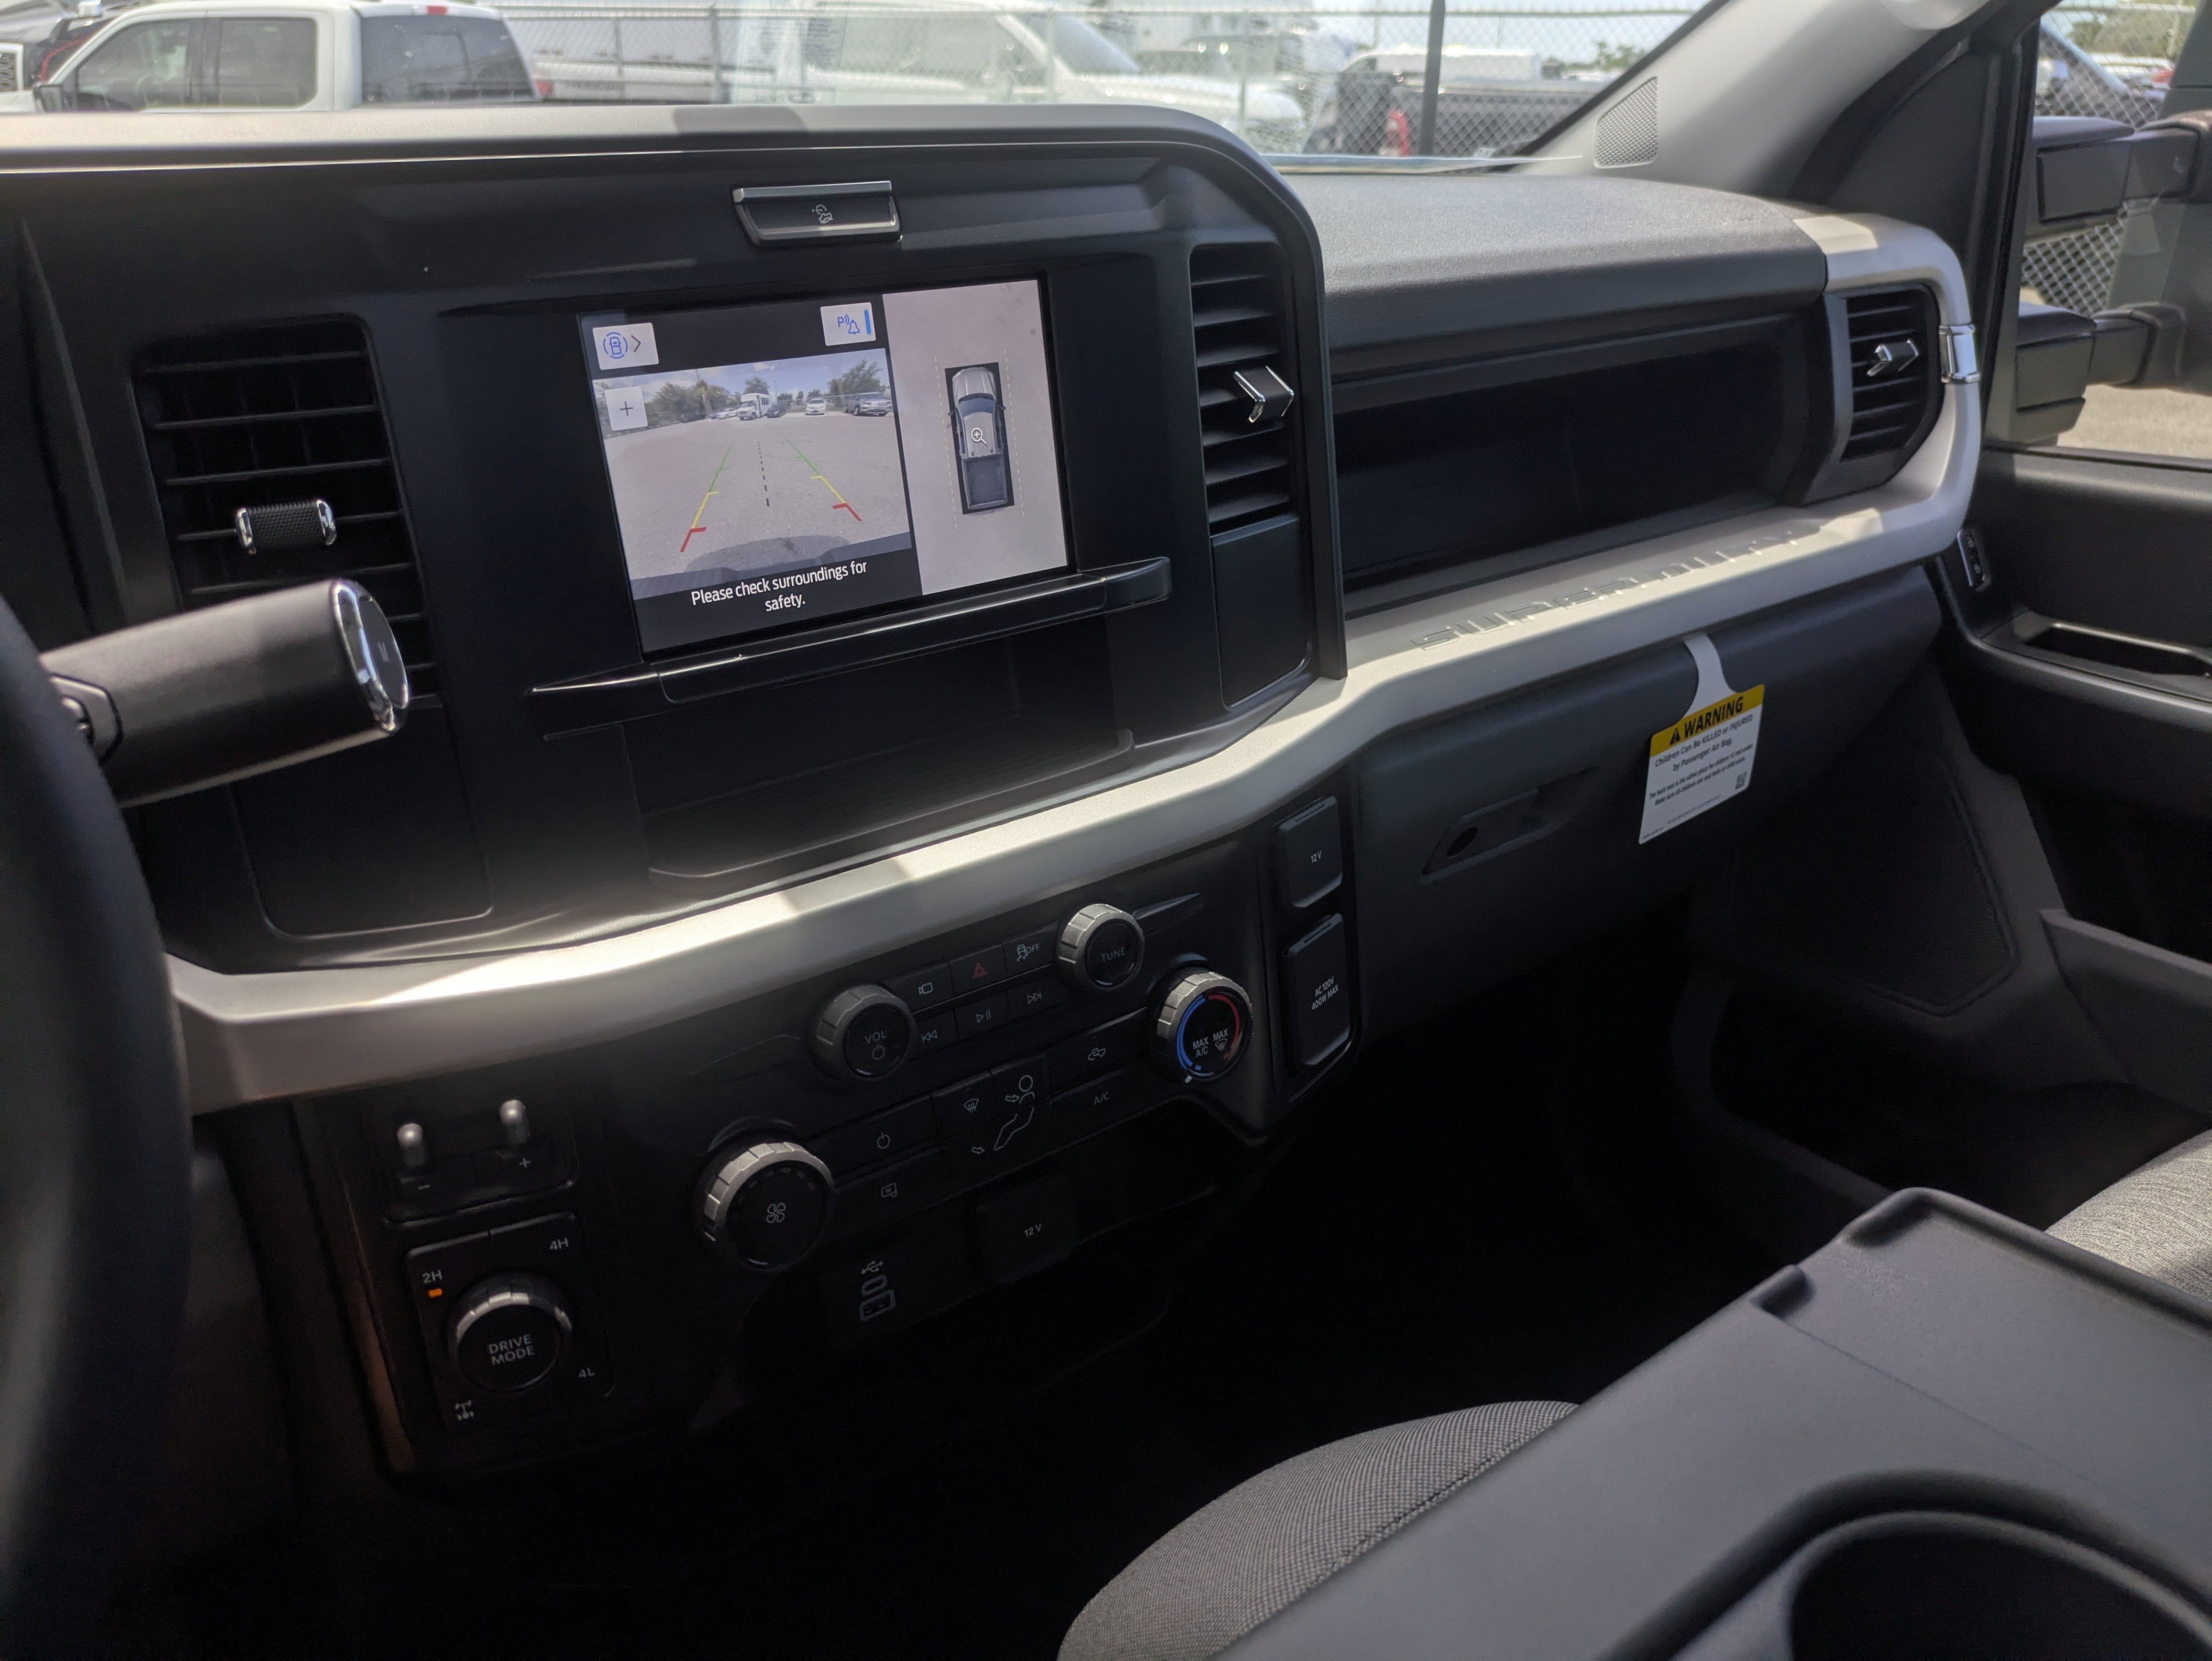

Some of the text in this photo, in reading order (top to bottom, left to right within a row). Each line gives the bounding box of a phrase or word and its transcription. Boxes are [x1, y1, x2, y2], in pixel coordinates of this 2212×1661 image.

[691, 561, 867, 606] Please check surroundings for
[765, 593, 806, 612] safety.
[1684, 696, 1744, 738] WARNING
[1655, 750, 1680, 767] Children
[1680, 744, 1692, 755] Can
[1693, 739, 1701, 749] Be
[1702, 729, 1721, 743] KILLED
[1729, 714, 1753, 731] INJURED
[1672, 762, 1680, 773] by
[1681, 747, 1710, 768] Passenger
[1025, 943, 1040, 954] OFF
[1100, 947, 1125, 962] TUNE
[1315, 975, 1334, 997] AC 120V
[1311, 984, 1338, 1010] 400W MAX
[864, 1030, 887, 1044] VOL
[1213, 1028, 1228, 1041] MAX
[1193, 1036, 1208, 1050] MAX
[1196, 1046, 1208, 1058] A/C
[1094, 1092, 1109, 1105] A/C
[550, 1238, 569, 1250] 4H
[422, 1270, 442, 1284] 2H
[488, 1334, 532, 1354] DRIVE
[491, 1345, 535, 1366] MODE
[579, 1368, 595, 1378] 4L
